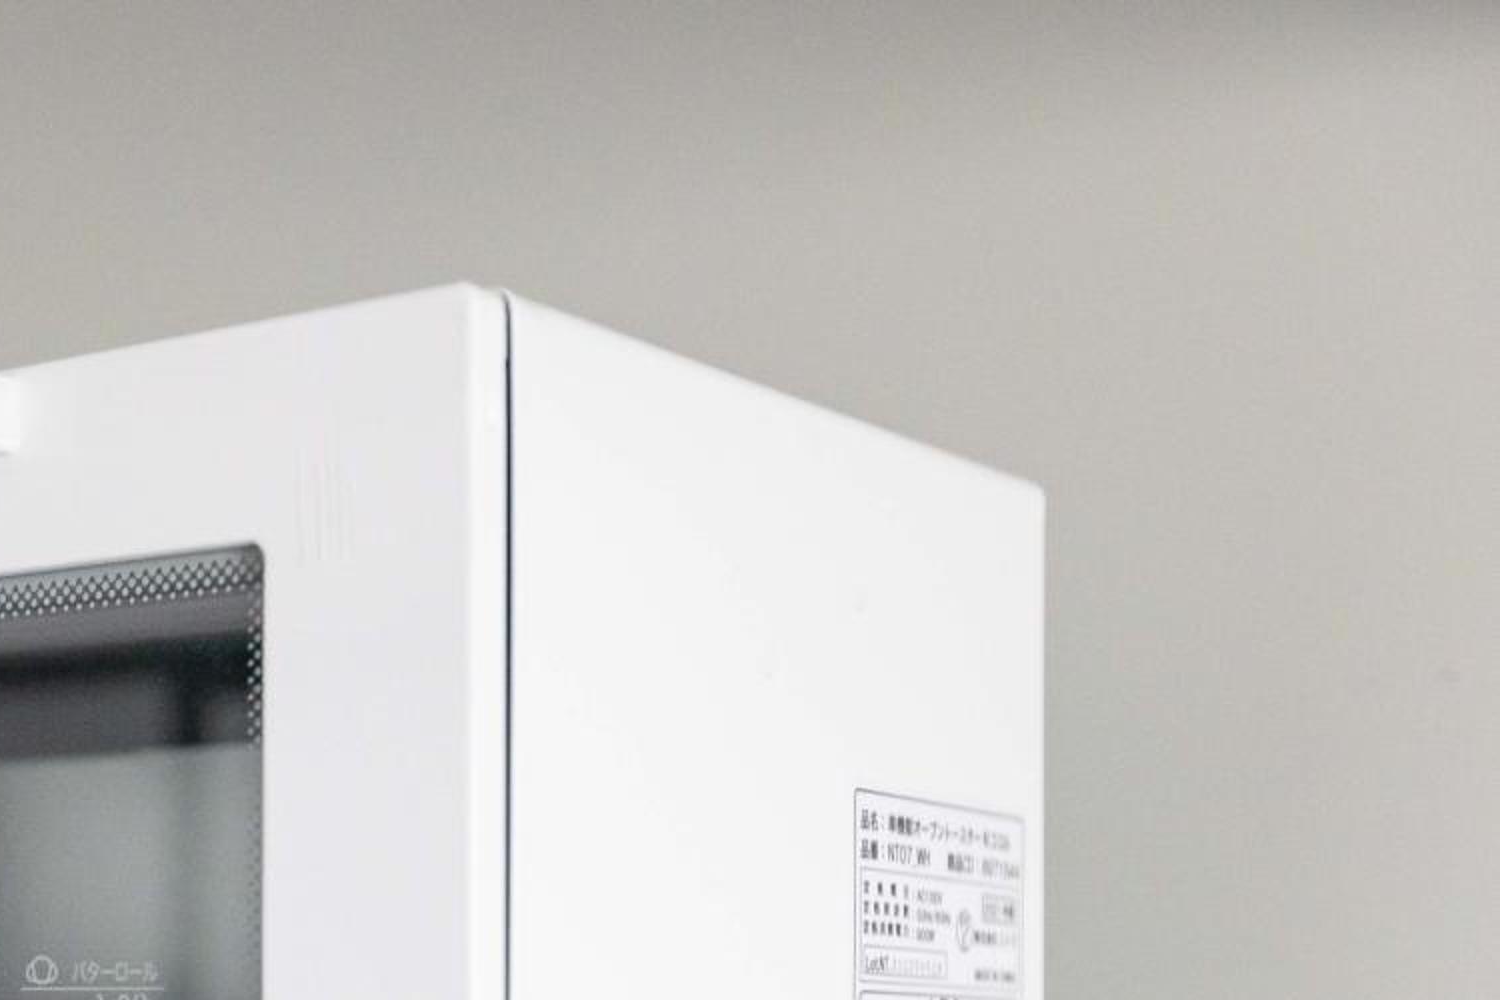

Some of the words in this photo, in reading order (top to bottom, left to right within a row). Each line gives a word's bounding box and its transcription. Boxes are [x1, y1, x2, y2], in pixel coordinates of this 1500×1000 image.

[72, 961, 158, 983] バターロール
